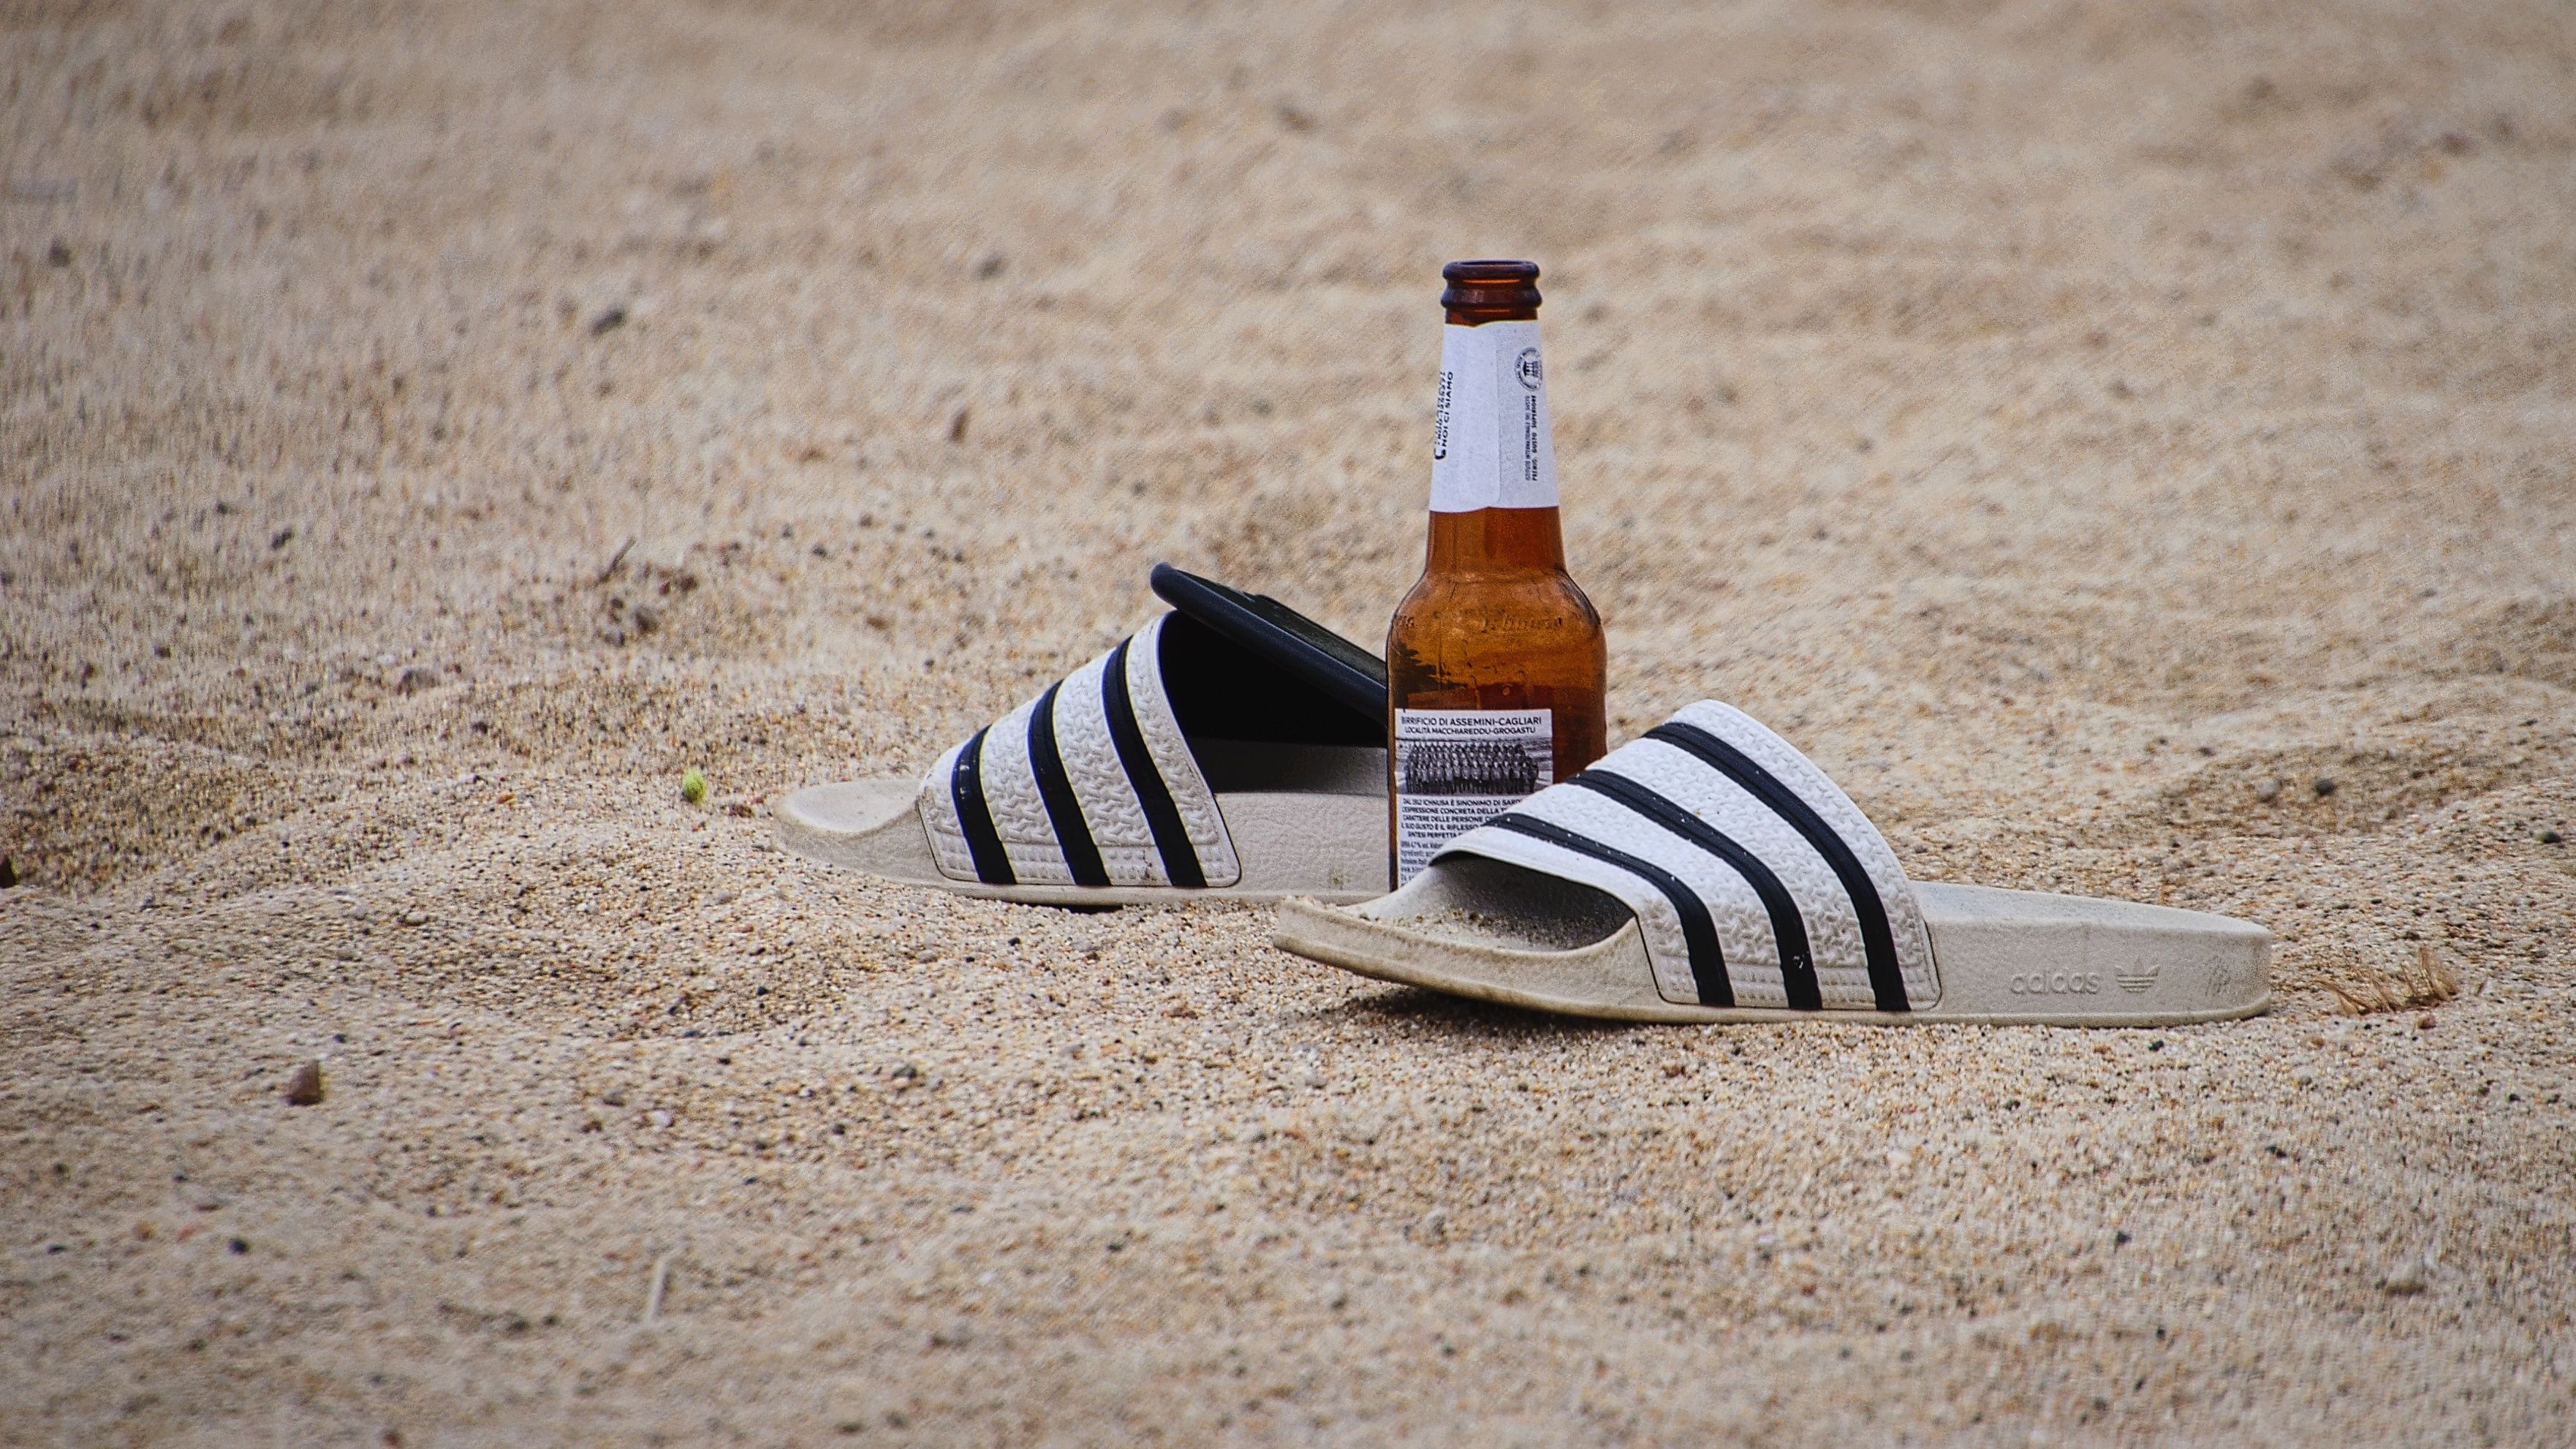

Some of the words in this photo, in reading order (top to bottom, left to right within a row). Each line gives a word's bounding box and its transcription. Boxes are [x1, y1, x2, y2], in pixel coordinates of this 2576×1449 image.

[1444, 371, 1453, 409] SIAMO
[1444, 412, 1450, 423] CI
[1439, 718, 1447, 726] DI
[1450, 716, 1542, 726] ASSEMINI-CAGLIARI
[2011, 968, 2101, 994] adidas
